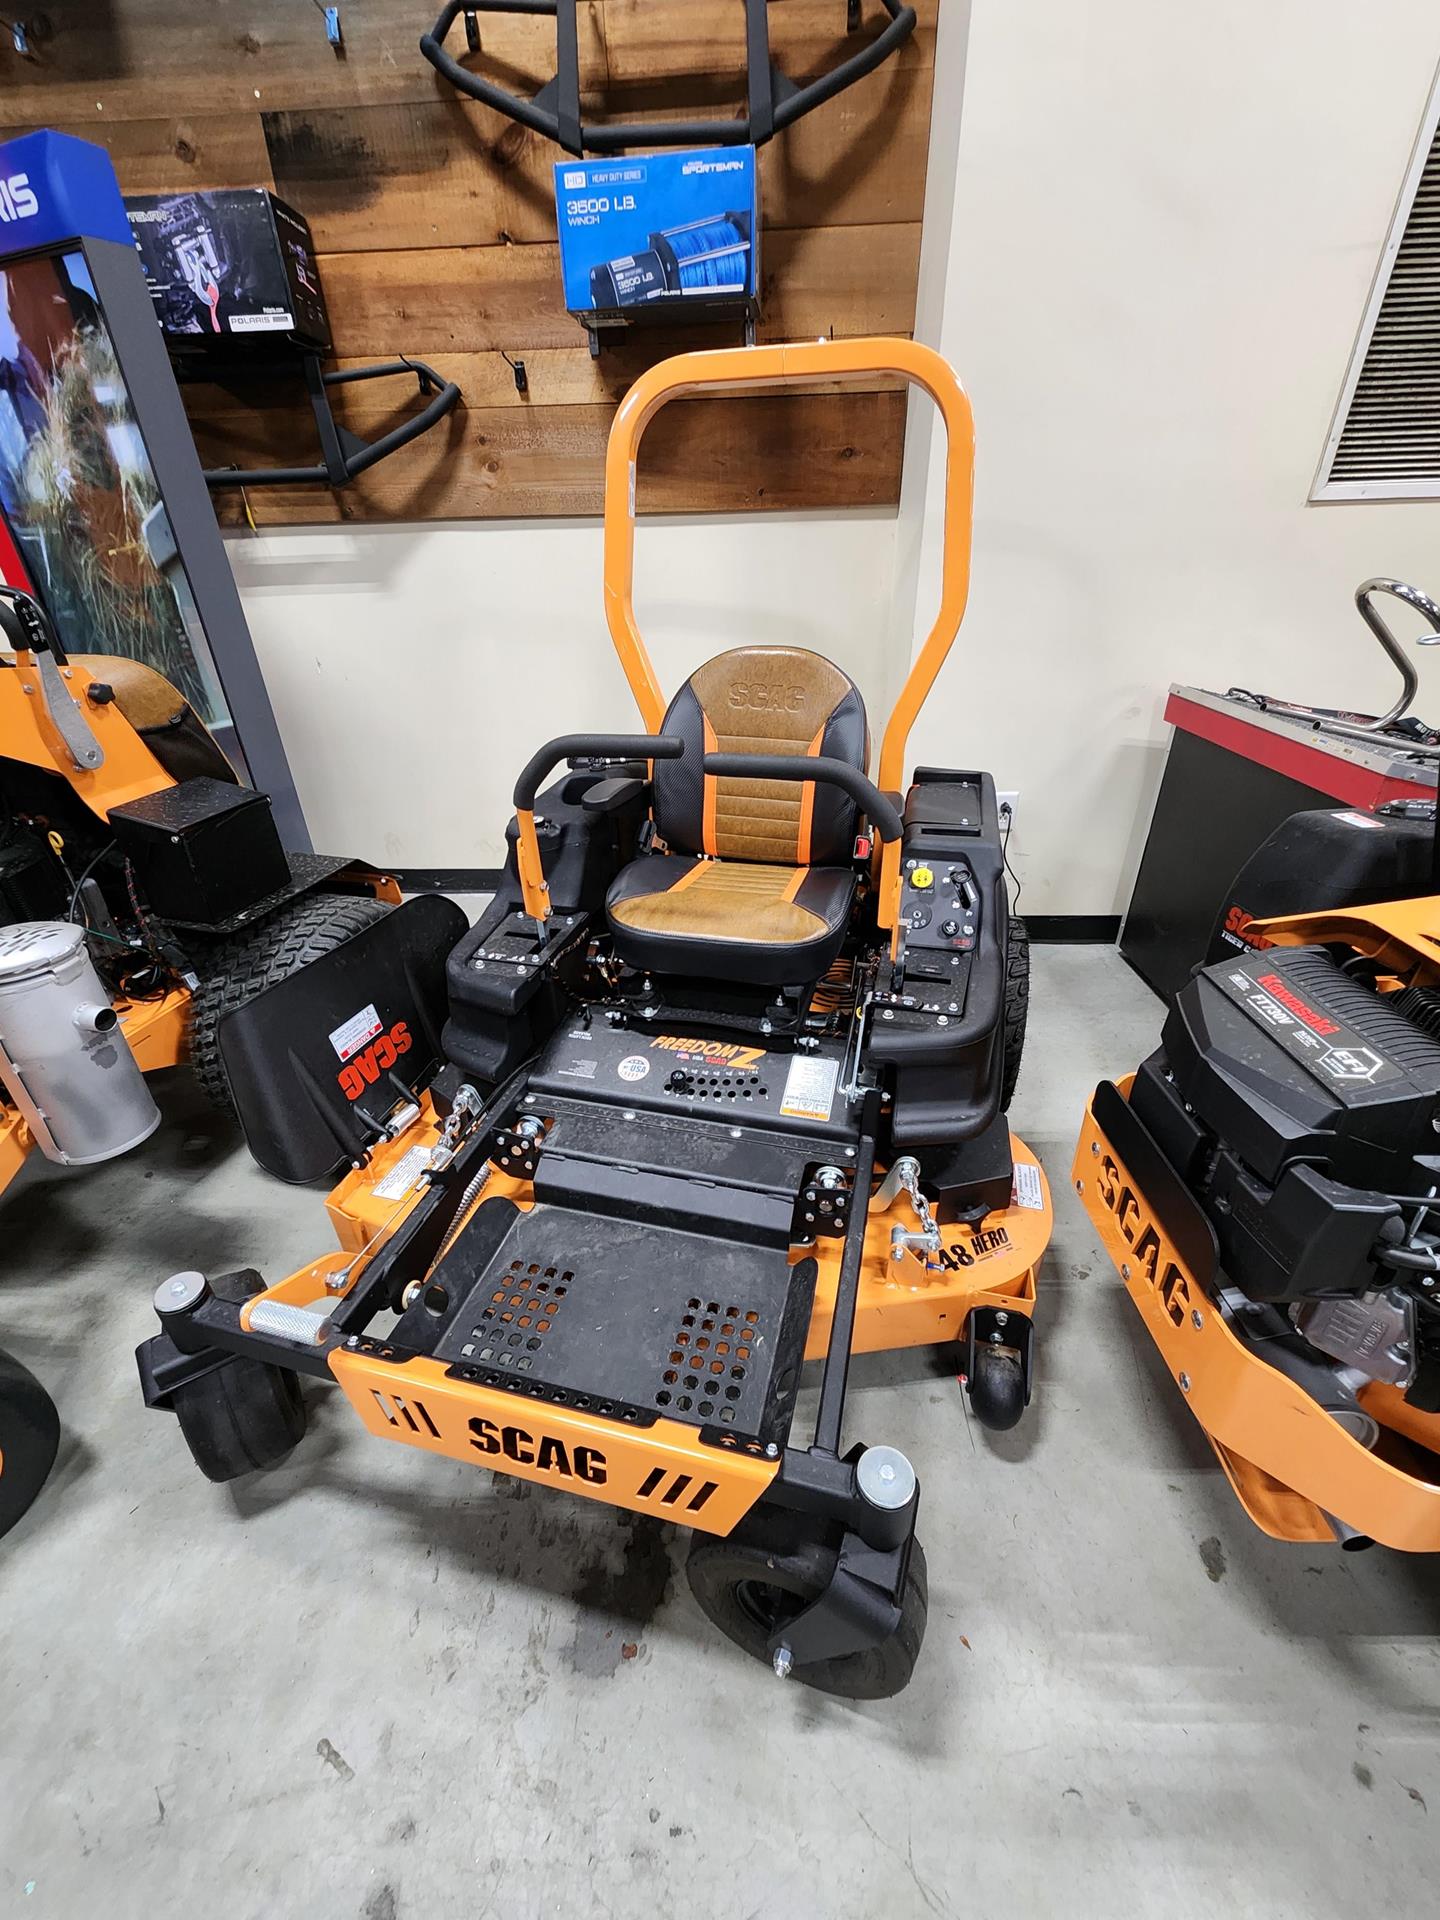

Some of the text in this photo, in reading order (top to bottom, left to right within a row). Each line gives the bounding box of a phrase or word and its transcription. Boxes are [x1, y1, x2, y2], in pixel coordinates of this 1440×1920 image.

[592, 173, 609, 184] HEAVY
[609, 172, 623, 182] DUTY
[624, 170, 641, 181] SERIES
[682, 161, 744, 175] SPORTSMAN
[567, 198, 610, 215] 3500
[568, 215, 600, 227] WINCH
[230, 316, 271, 325] POLARIS
[728, 682, 805, 713] SCAG
[1249, 994, 1296, 1025] FT730V
[1257, 974, 1340, 1036] Kawasaki
[337, 1021, 413, 1100] SCAG
[1332, 1051, 1370, 1074] EFI
[970, 1227, 1009, 1256] HERO
[1097, 1155, 1190, 1327] SCAG
[939, 1244, 975, 1271] 48
[468, 1417, 608, 1486] SCAG
